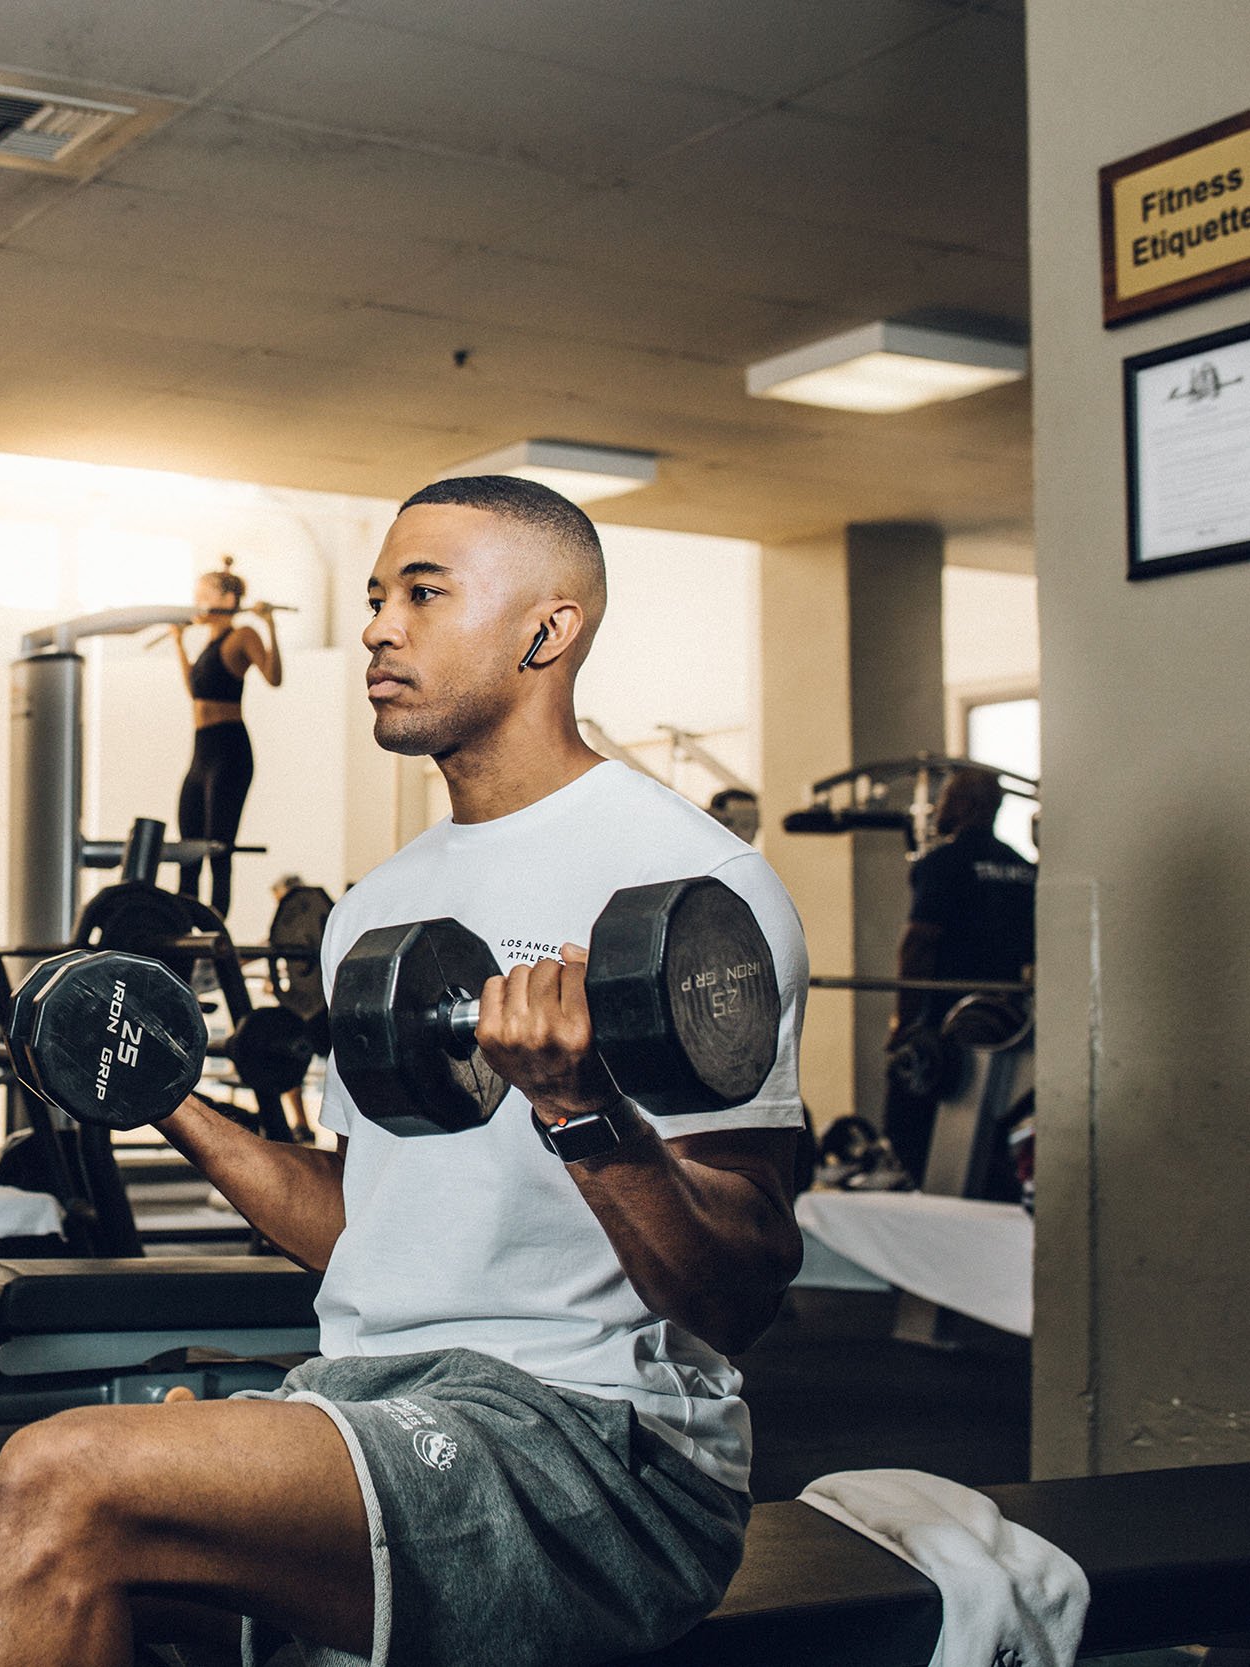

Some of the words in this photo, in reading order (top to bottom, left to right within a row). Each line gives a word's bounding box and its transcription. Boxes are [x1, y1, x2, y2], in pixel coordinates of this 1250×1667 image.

[1141, 167, 1244, 223] Fitness
[1132, 206, 1250, 267] Etiquette
[500, 938, 522, 948] LOS
[525, 941, 562, 955] ANGEL
[726, 961, 760, 981] IRON
[106, 979, 126, 1034] IRON
[712, 988, 741, 1019] 25
[117, 1019, 143, 1068] 25
[95, 1047, 113, 1100] GRIP
